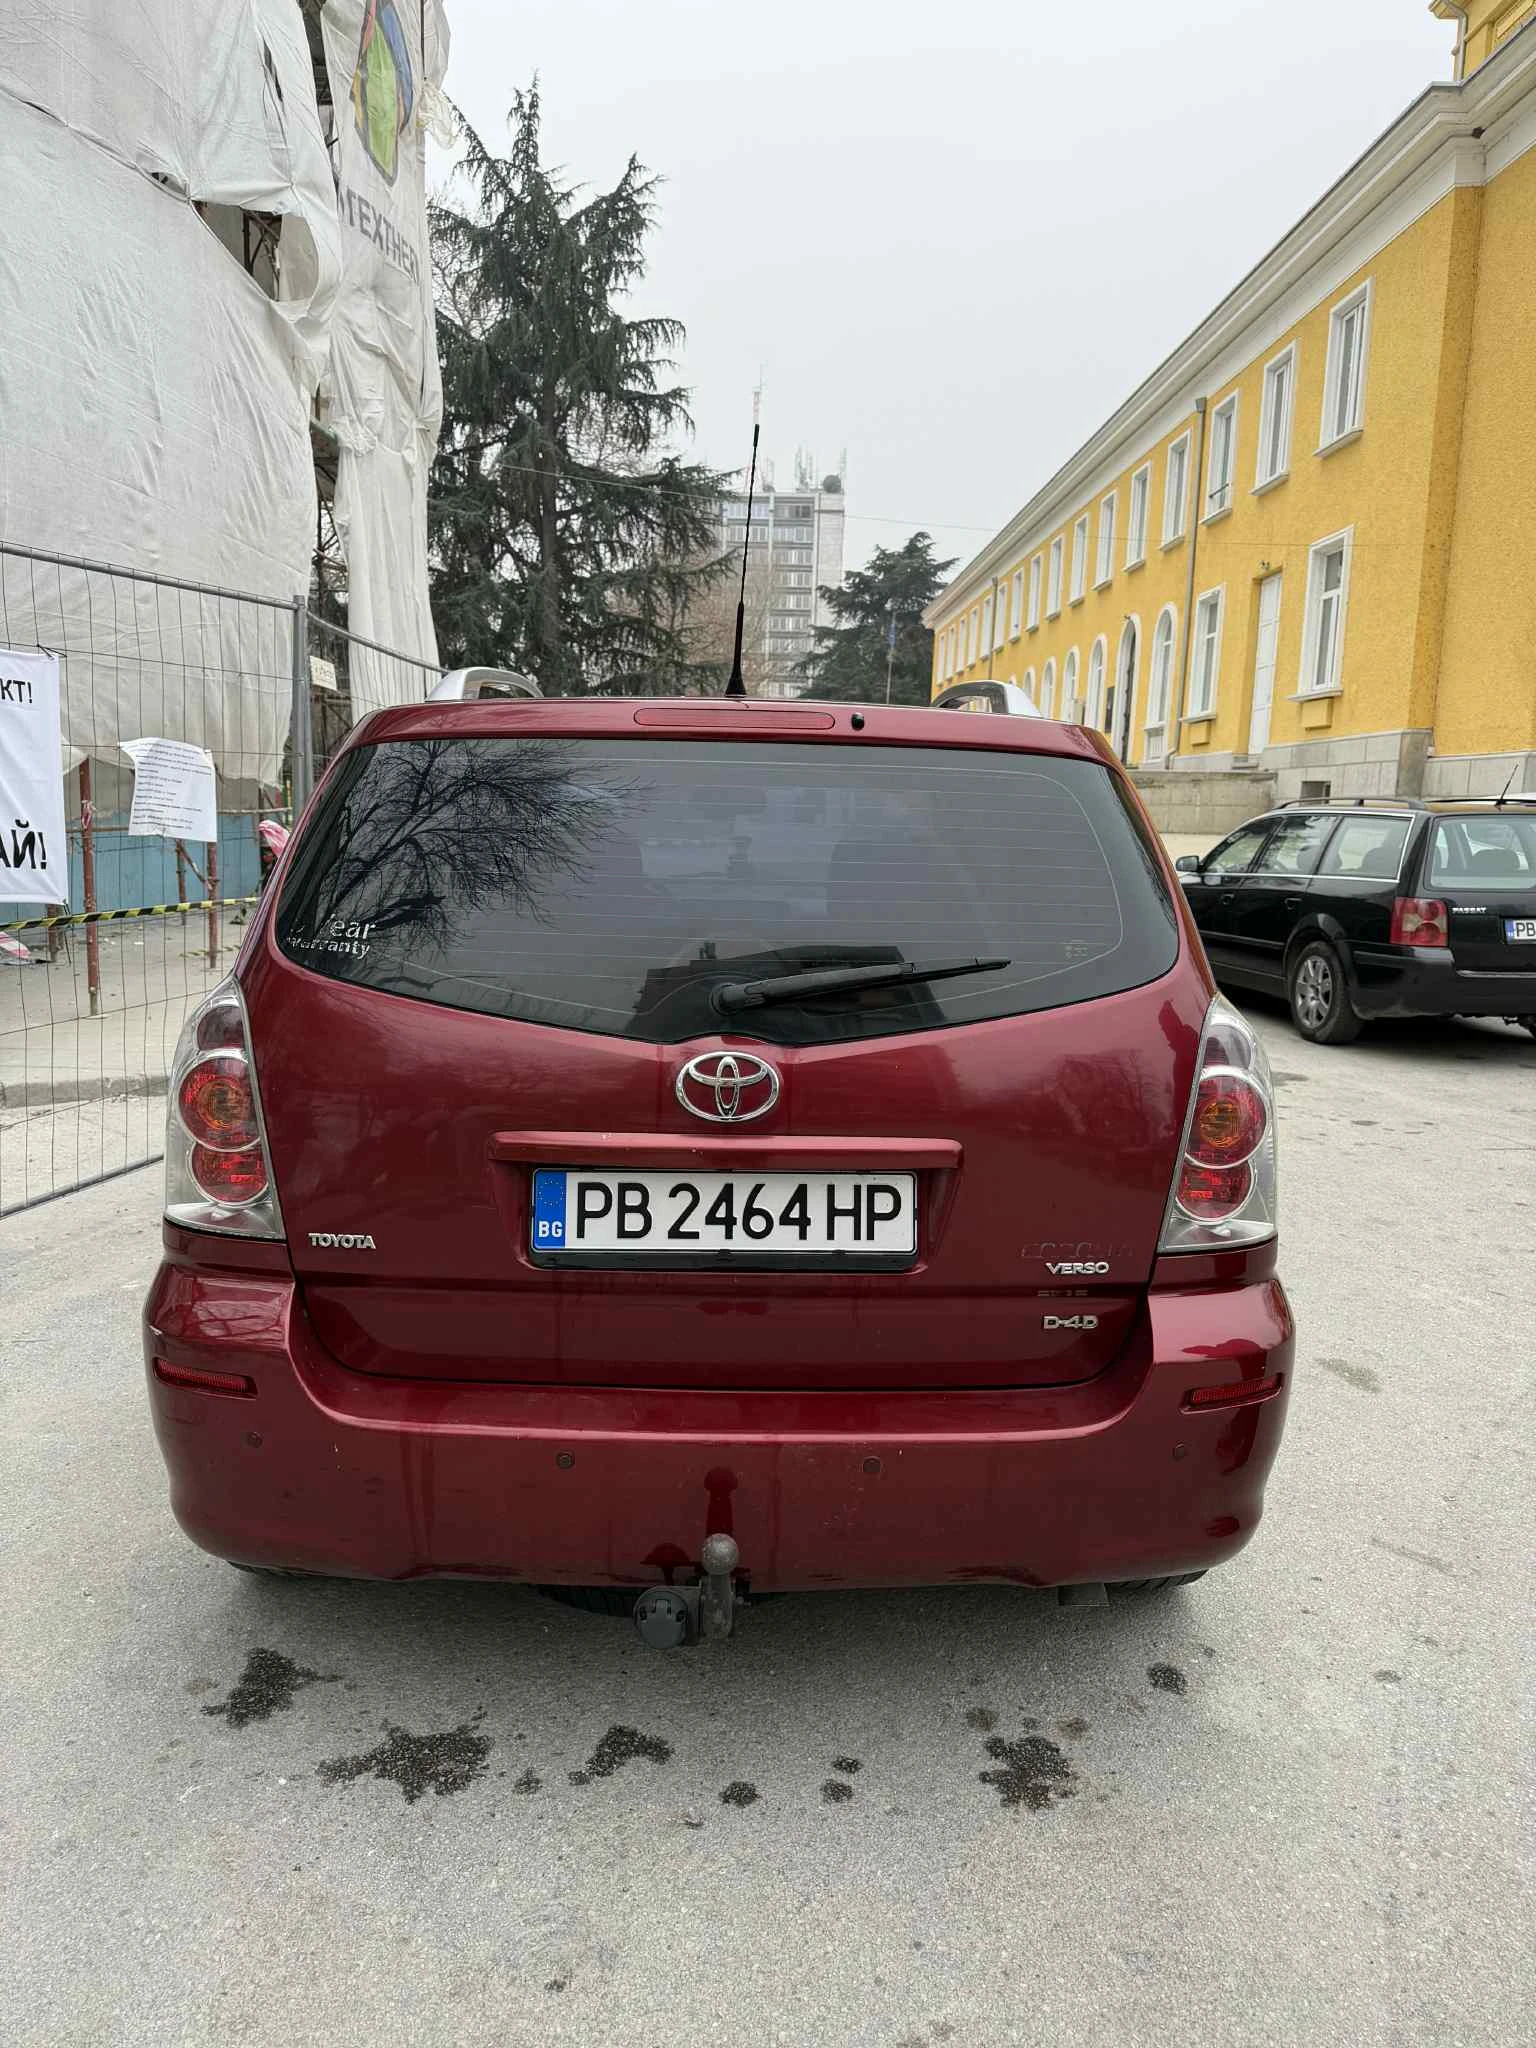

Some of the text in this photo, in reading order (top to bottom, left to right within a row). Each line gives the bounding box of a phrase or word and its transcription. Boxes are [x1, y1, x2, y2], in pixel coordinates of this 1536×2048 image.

[1516, 922, 1536, 937] PB
[576, 1182, 902, 1241] PB 2464 HP
[538, 1221, 563, 1239] BG
[308, 1232, 377, 1249] TOYOTA
[1045, 1261, 1110, 1275] VERSO
[1043, 1314, 1098, 1330] D-4D
